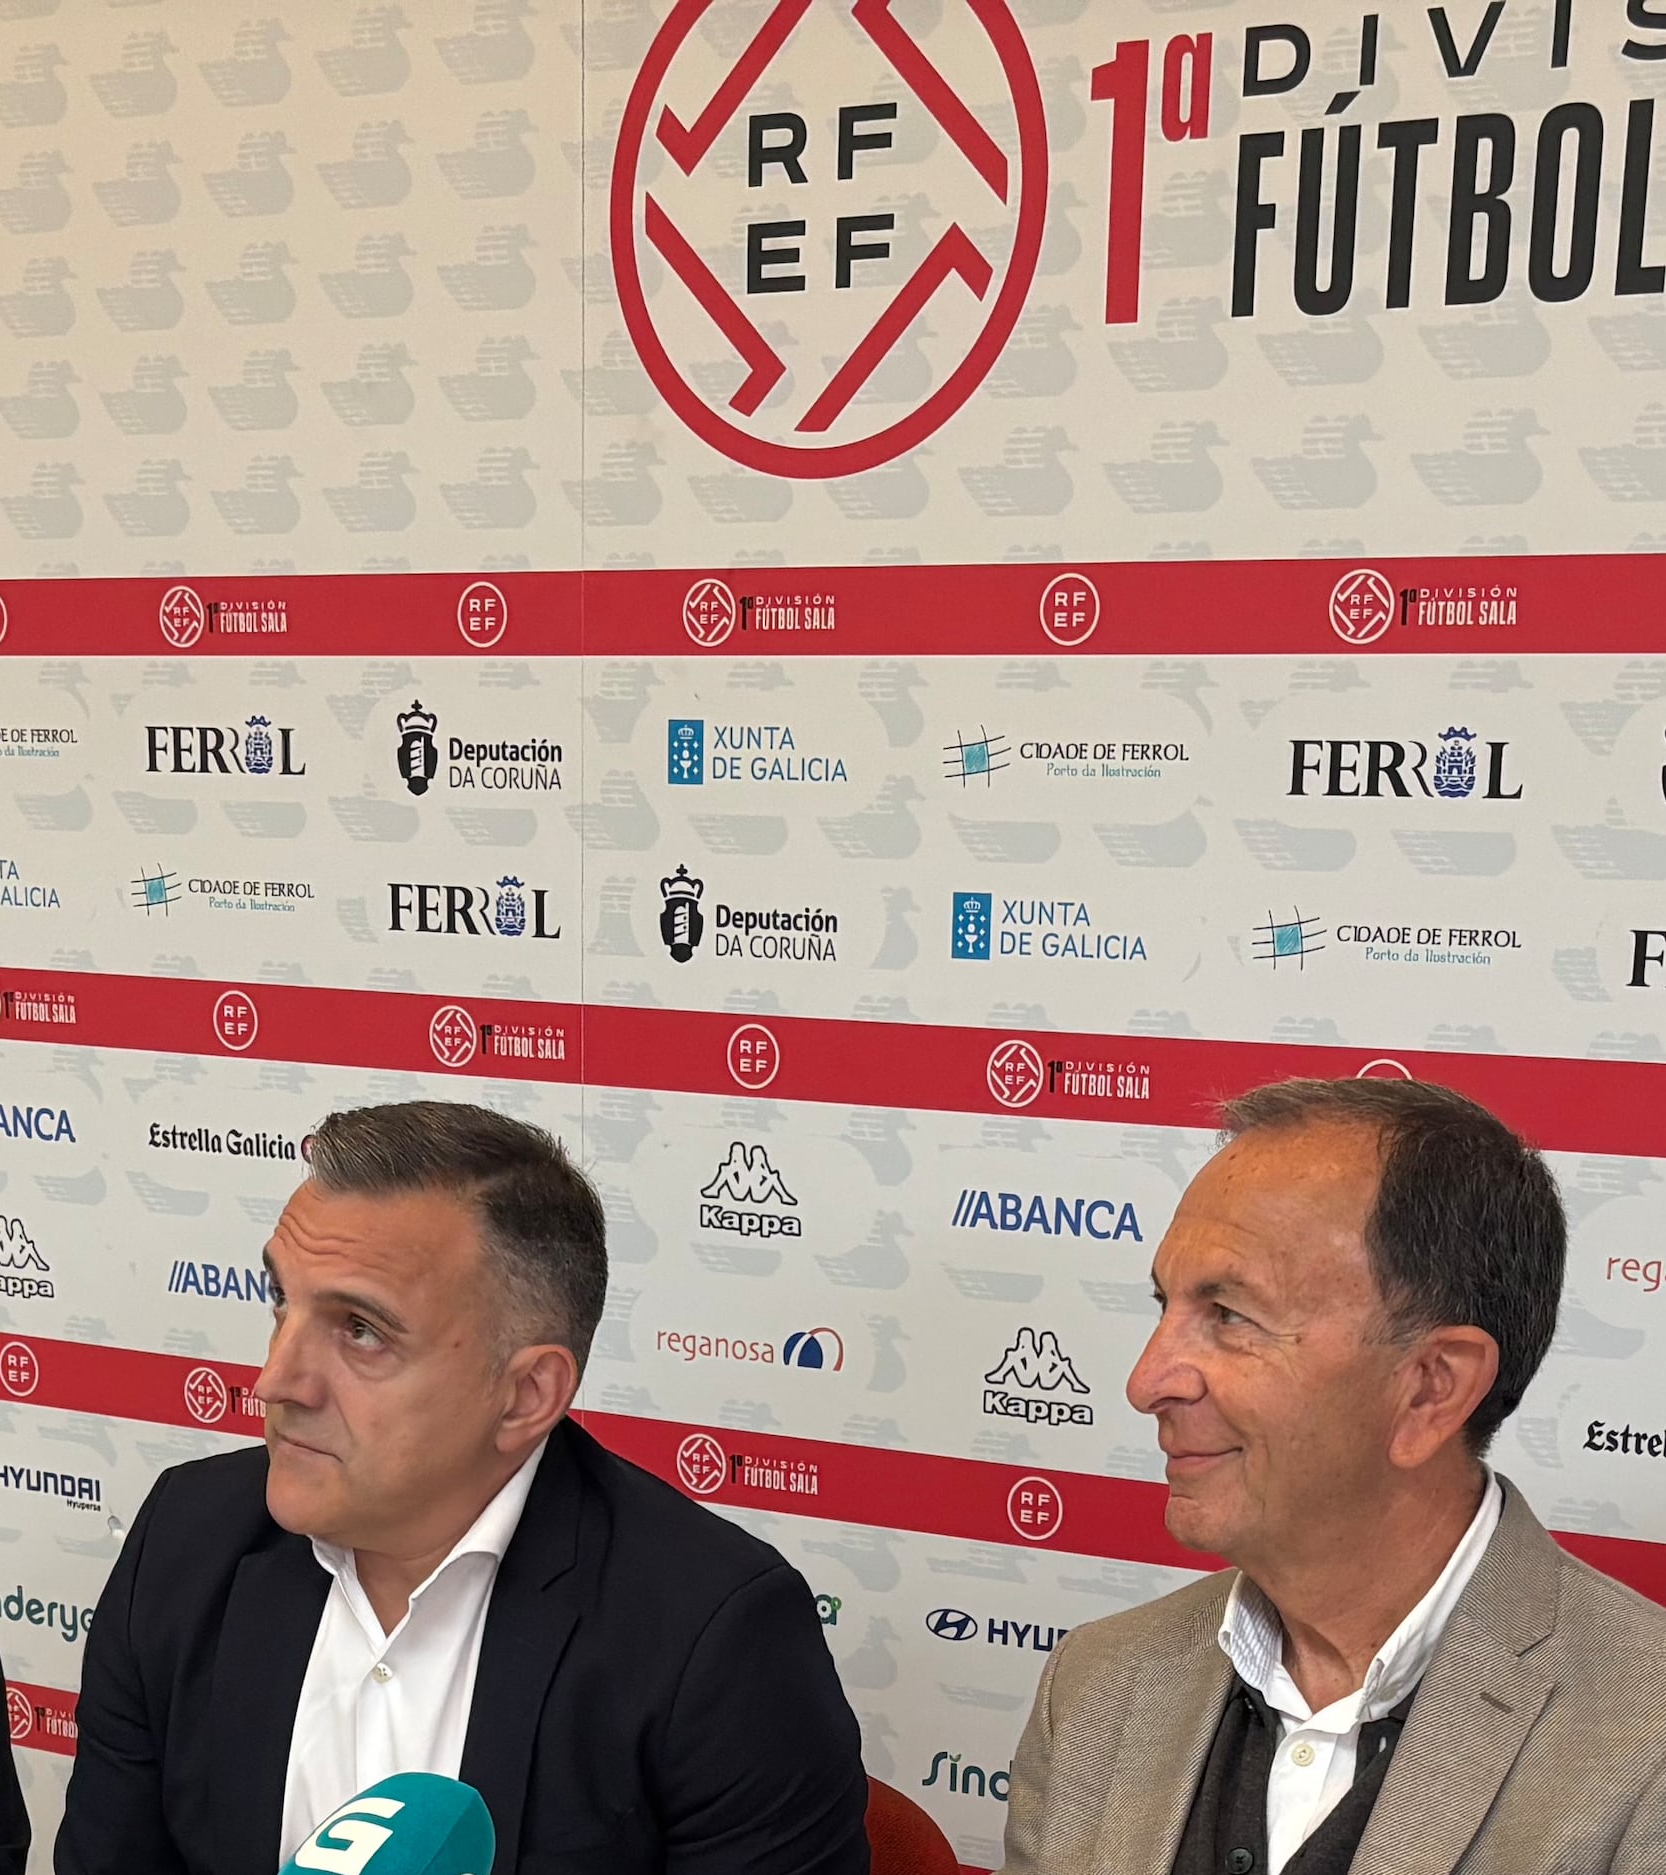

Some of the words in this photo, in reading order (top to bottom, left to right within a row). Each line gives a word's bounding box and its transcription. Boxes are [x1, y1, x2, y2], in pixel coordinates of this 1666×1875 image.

[1091, 32, 1212, 324] 1ª
[1232, 85, 1666, 317] FÚTBOL
[1421, 588, 1516, 598] DIVISIÓN
[1419, 601, 1473, 625] FÚTBOL
[1479, 601, 1516, 625] SALA
[11, 729, 27, 742] DE
[31, 729, 77, 743] FERROL
[714, 727, 794, 750] XUNTA
[450, 738, 561, 773] Deputación
[1020, 743, 1088, 759] CIDADE
[1094, 744, 1116, 759] DE
[1123, 744, 1189, 761] FERROL
[450, 766, 475, 788] DA
[477, 754, 561, 790] CORUÑA
[713, 757, 741, 779] DE
[751, 757, 847, 781] GALICIA
[1047, 763, 1077, 776] Porto
[1082, 764, 1095, 776] da
[189, 879, 239, 894] CIDADE
[244, 882, 260, 895] DE
[265, 883, 314, 898] FERROL
[716, 905, 837, 941] Deputación
[1002, 900, 1090, 926] XUNTA
[716, 934, 742, 957] DA
[750, 934, 835, 961] CORUÑA
[1001, 931, 1032, 955] DE
[1042, 933, 1146, 960] GALICIA
[1337, 926, 1411, 943] CIDADE
[1417, 929, 1441, 944] DE
[1449, 929, 1521, 948] FERROL
[1366, 947, 1399, 960] Porto
[1404, 949, 1418, 961] da
[1065, 1061, 1151, 1075] DIVISIÓN
[1064, 1070, 1112, 1097] FÚTBOL
[1116, 1075, 1150, 1099] SALA
[149, 1123, 221, 1153] Estrella
[227, 1129, 295, 1160] Galicia
[700, 1204, 801, 1238] Kappa
[658, 1332, 773, 1363] reganosa
[984, 1390, 1093, 1426] Kappa
